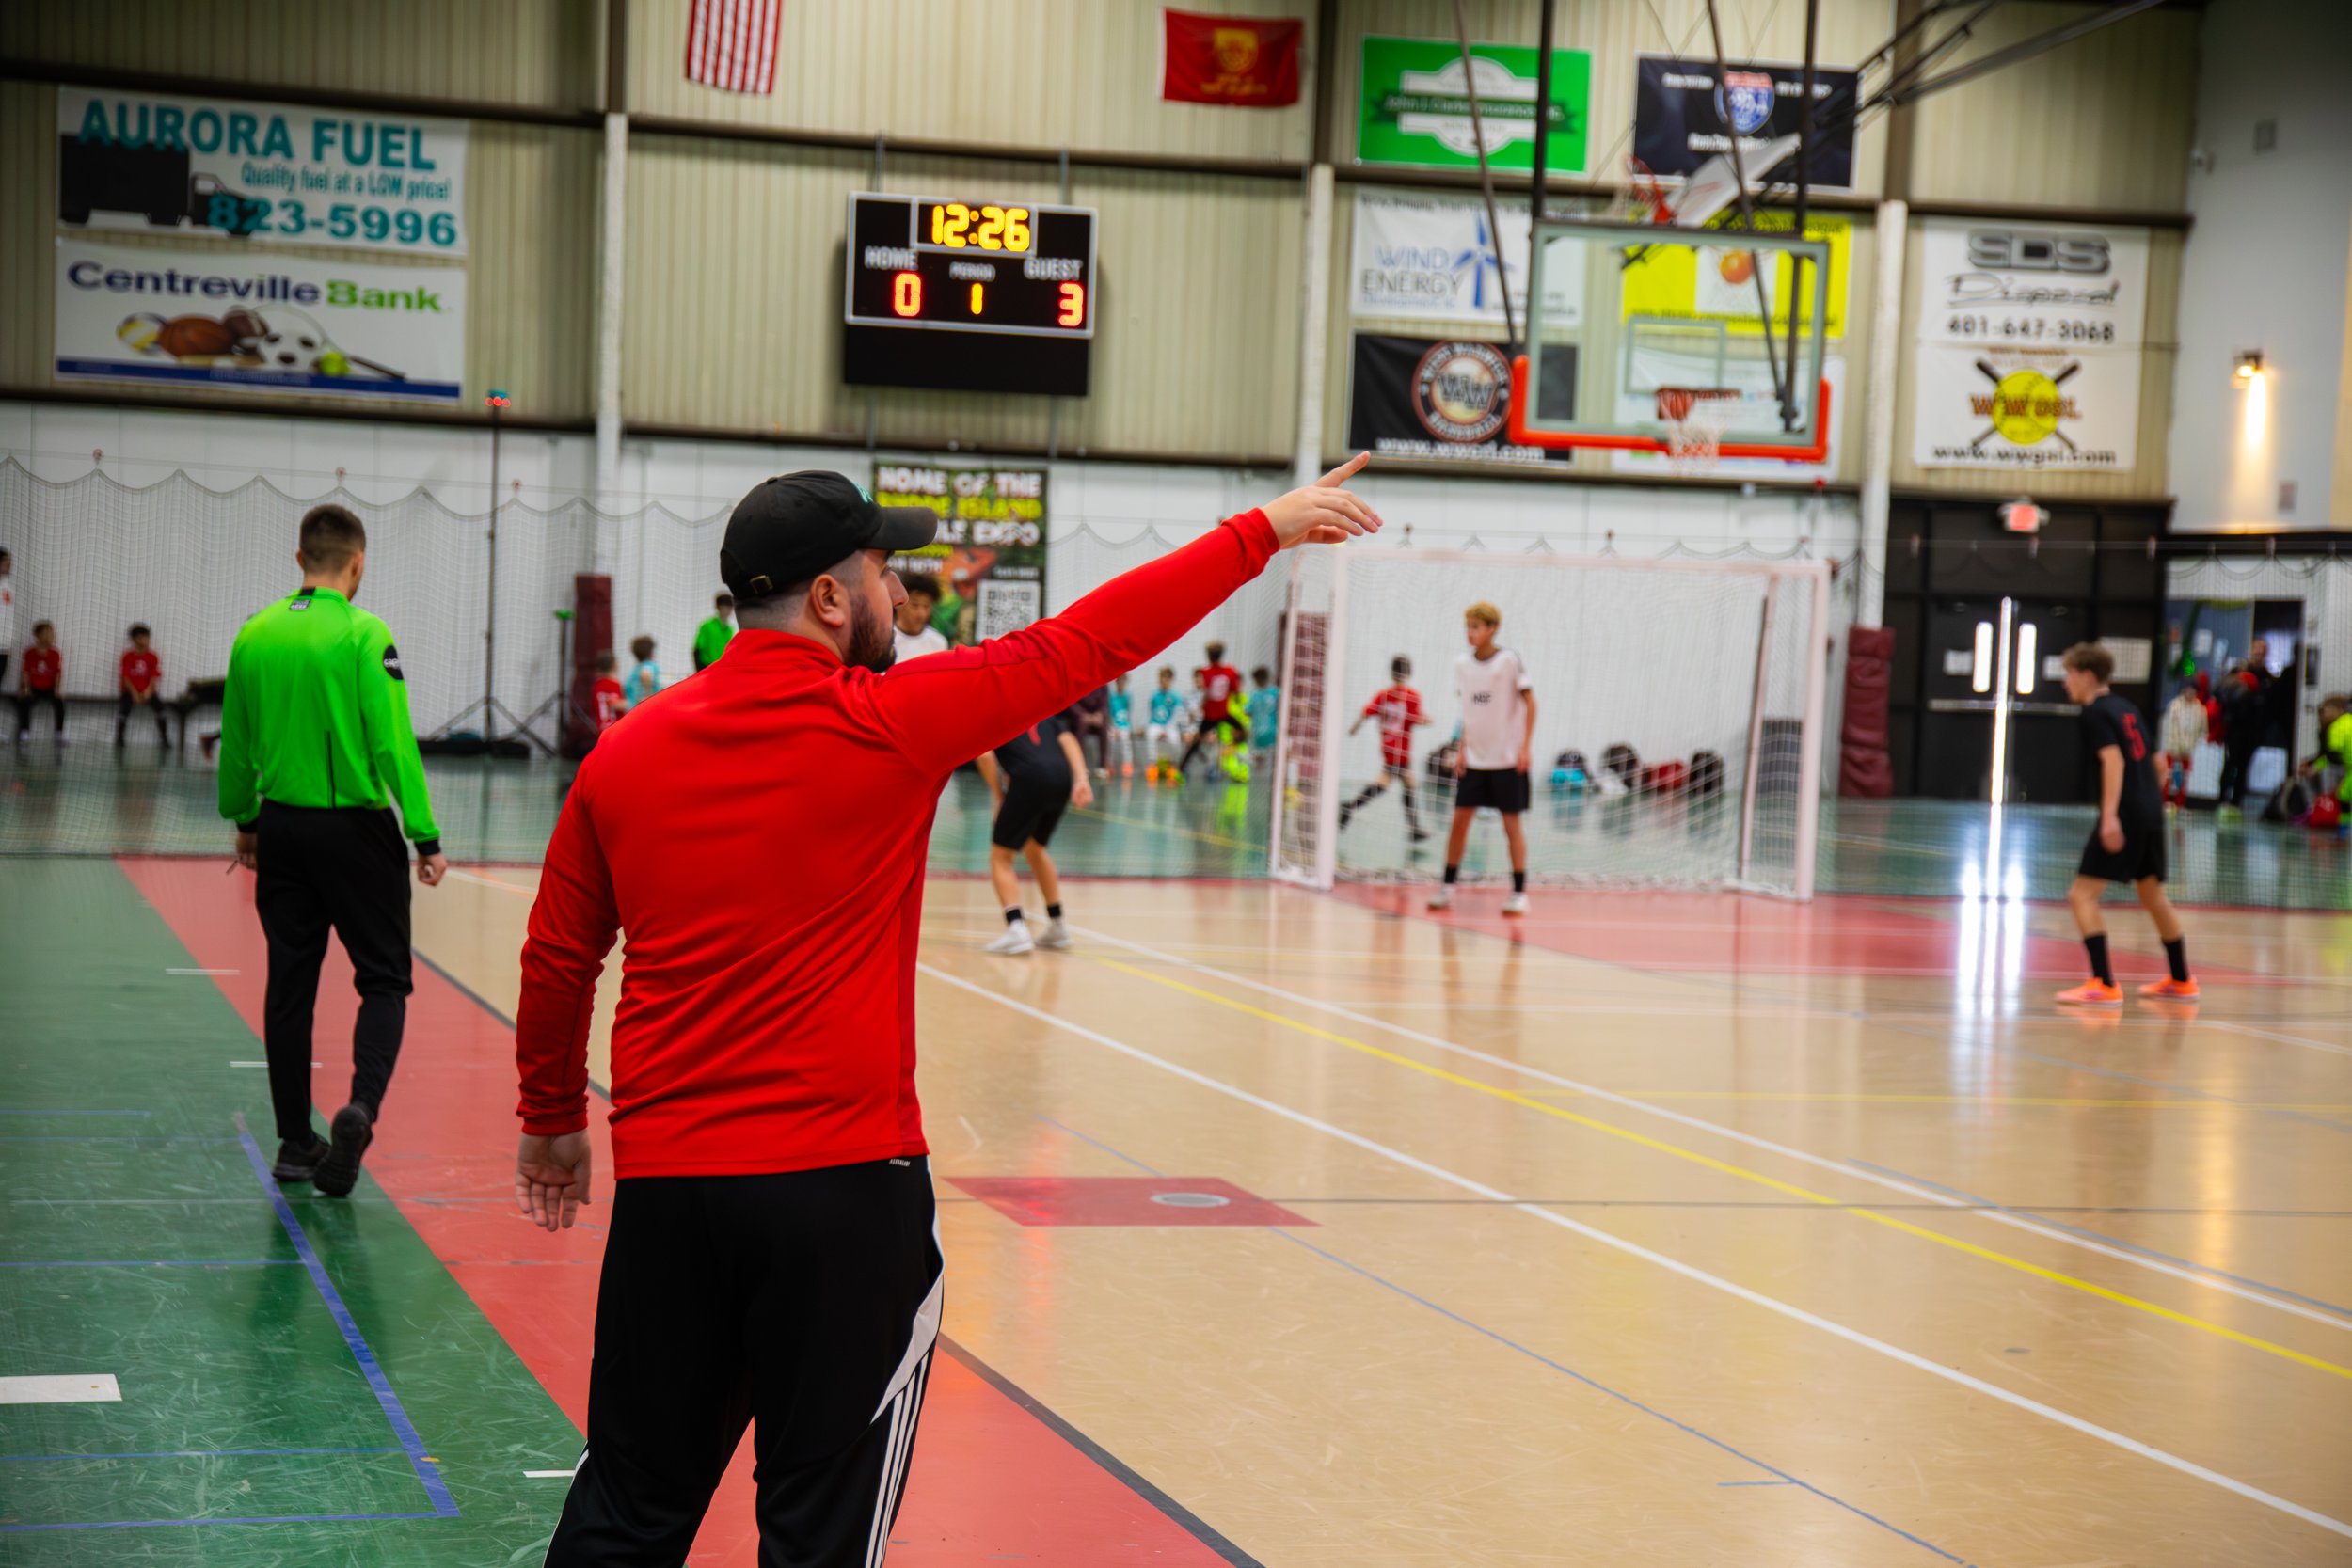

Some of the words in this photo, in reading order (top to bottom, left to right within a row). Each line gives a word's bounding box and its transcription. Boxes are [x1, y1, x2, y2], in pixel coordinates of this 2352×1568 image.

[79, 99, 293, 159] AURORA
[312, 119, 436, 171] FUEL
[242, 162, 294, 192] Quality
[301, 166, 329, 191] fuel
[334, 170, 351, 193] at
[355, 178, 363, 193] a
[368, 171, 402, 197] LOW
[207, 191, 457, 246] 823-5996
[931, 203, 1030, 252] 12:26
[865, 245, 918, 271] HOME
[1024, 257, 1083, 281] GUEST
[1375, 245, 1451, 270] WIND
[68, 261, 321, 304] Centreville
[326, 279, 442, 313] Bank
[893, 272, 922, 317] 0
[970, 283, 984, 315] 1
[1057, 282, 1084, 327] 3
[1361, 268, 1464, 296] ENERGY
[877, 467, 948, 496] HOME
[952, 472, 989, 497] OF
[994, 472, 1042, 498] THE
